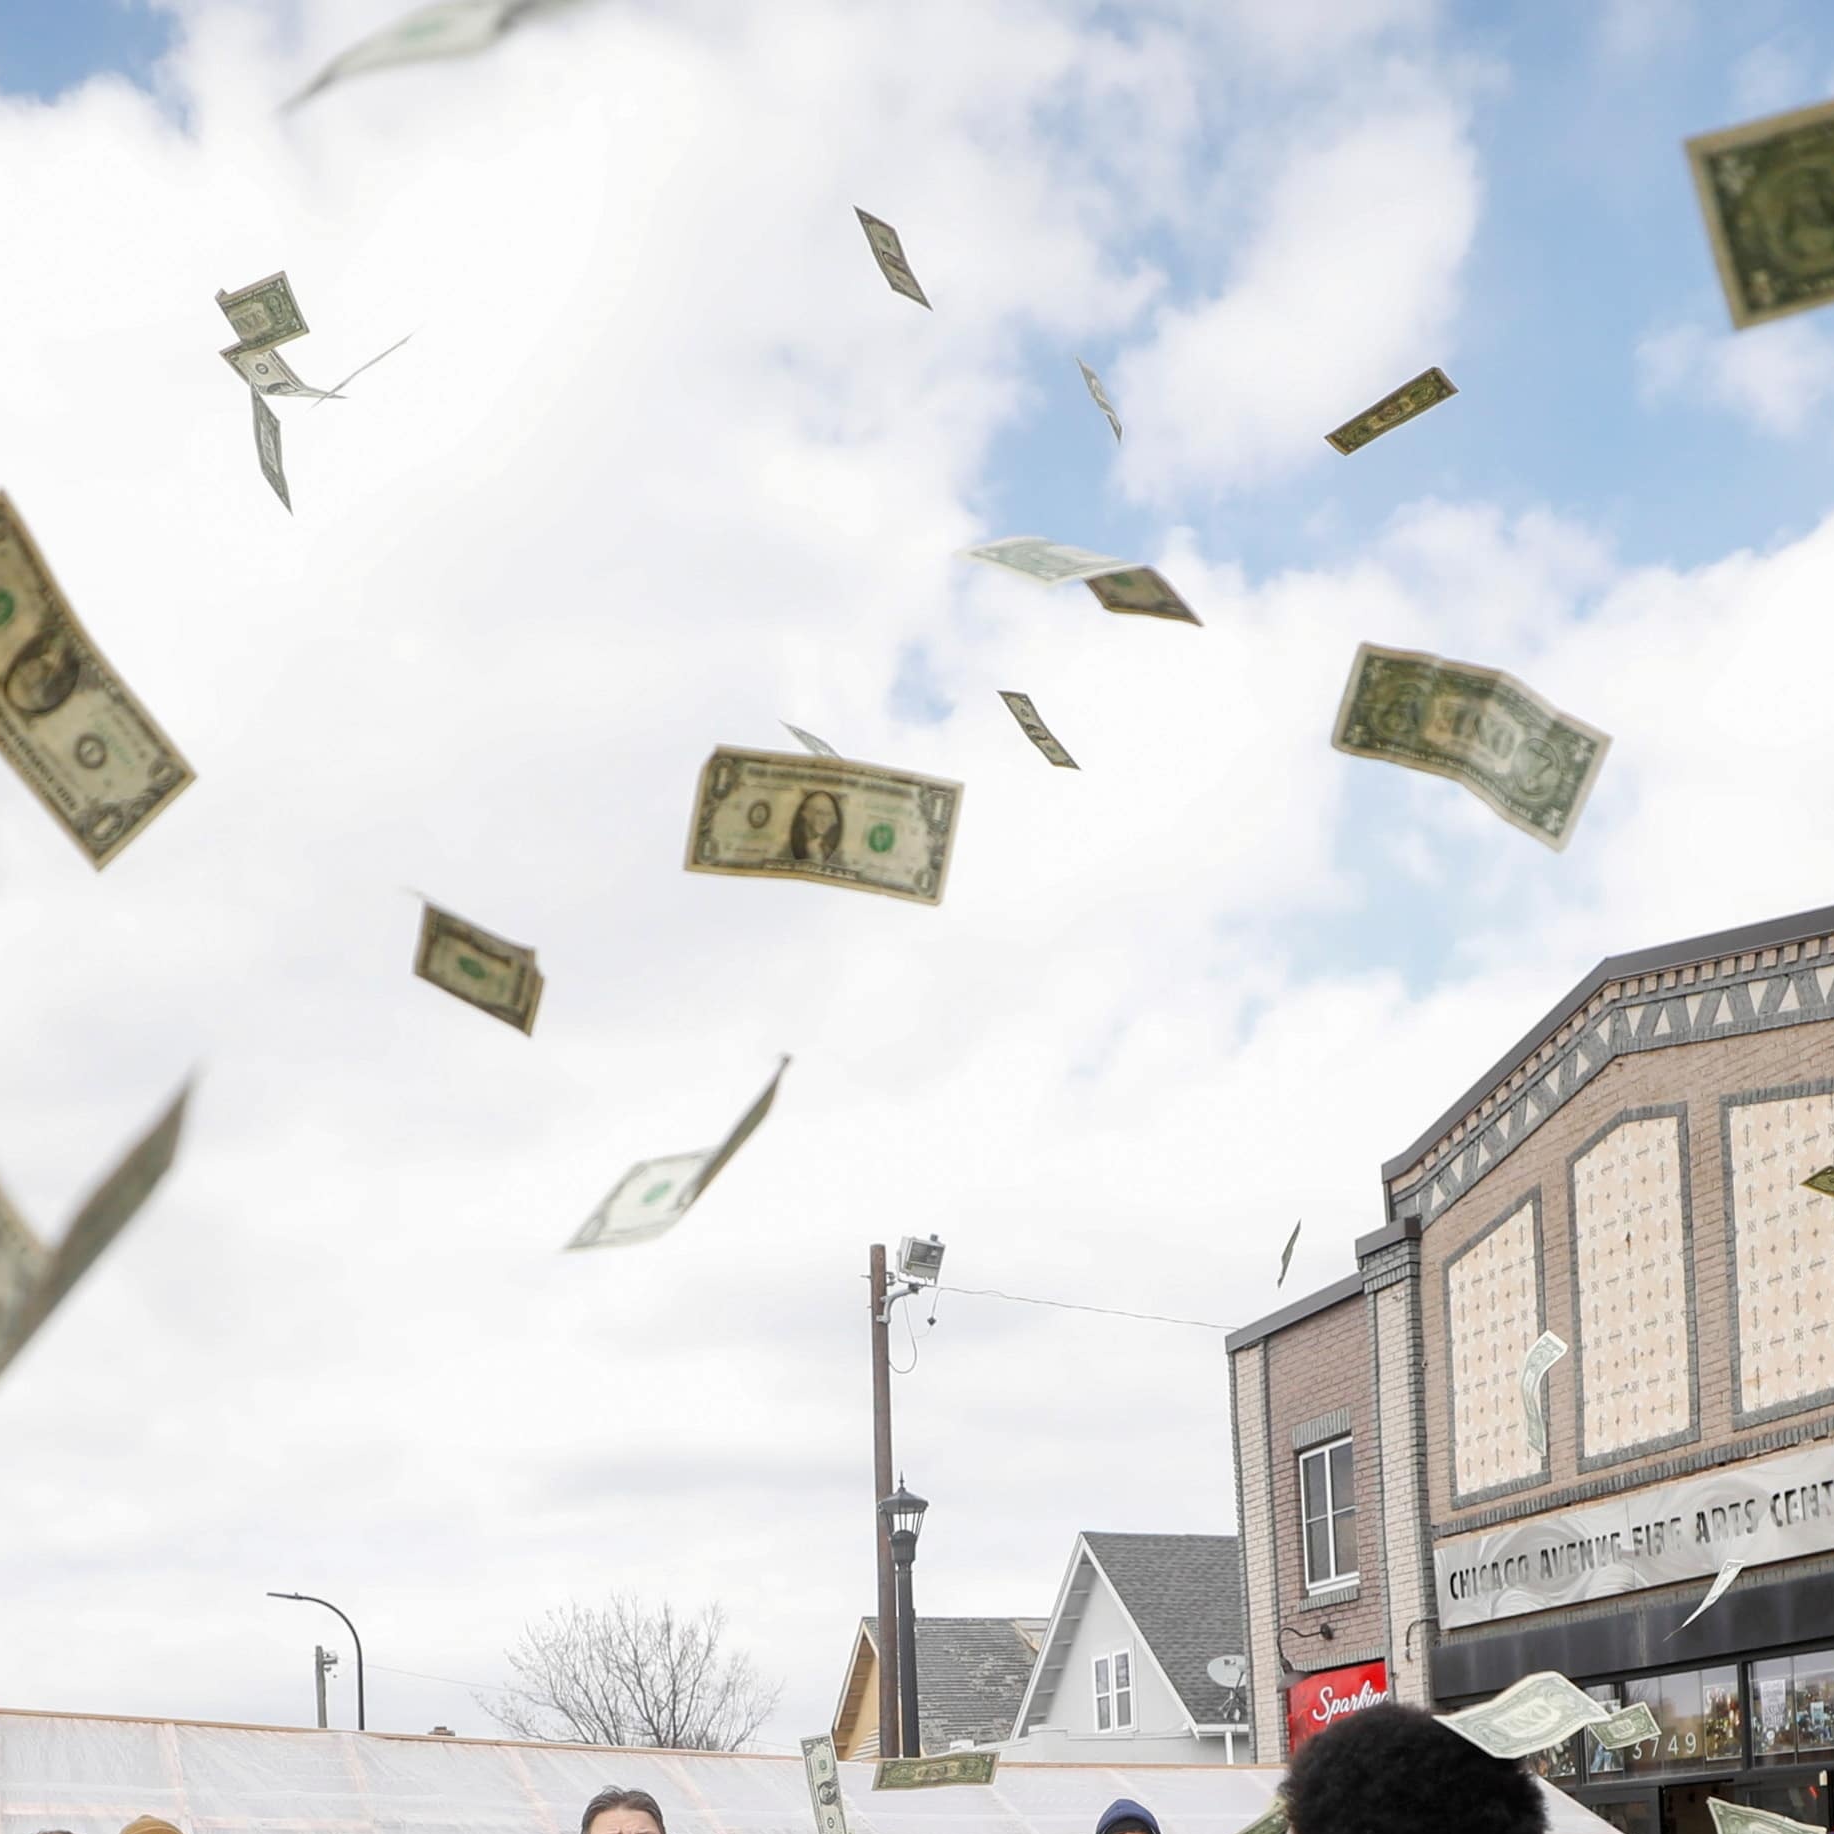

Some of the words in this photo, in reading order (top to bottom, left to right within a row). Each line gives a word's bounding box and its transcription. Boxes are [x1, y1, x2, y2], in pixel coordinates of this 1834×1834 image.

[1449, 1554, 1530, 1601] CHICAGO
[1539, 1531, 1621, 1580] AVENUE
[1631, 1516, 1683, 1557] FIRE
[1694, 1498, 1758, 1546] ARTS
